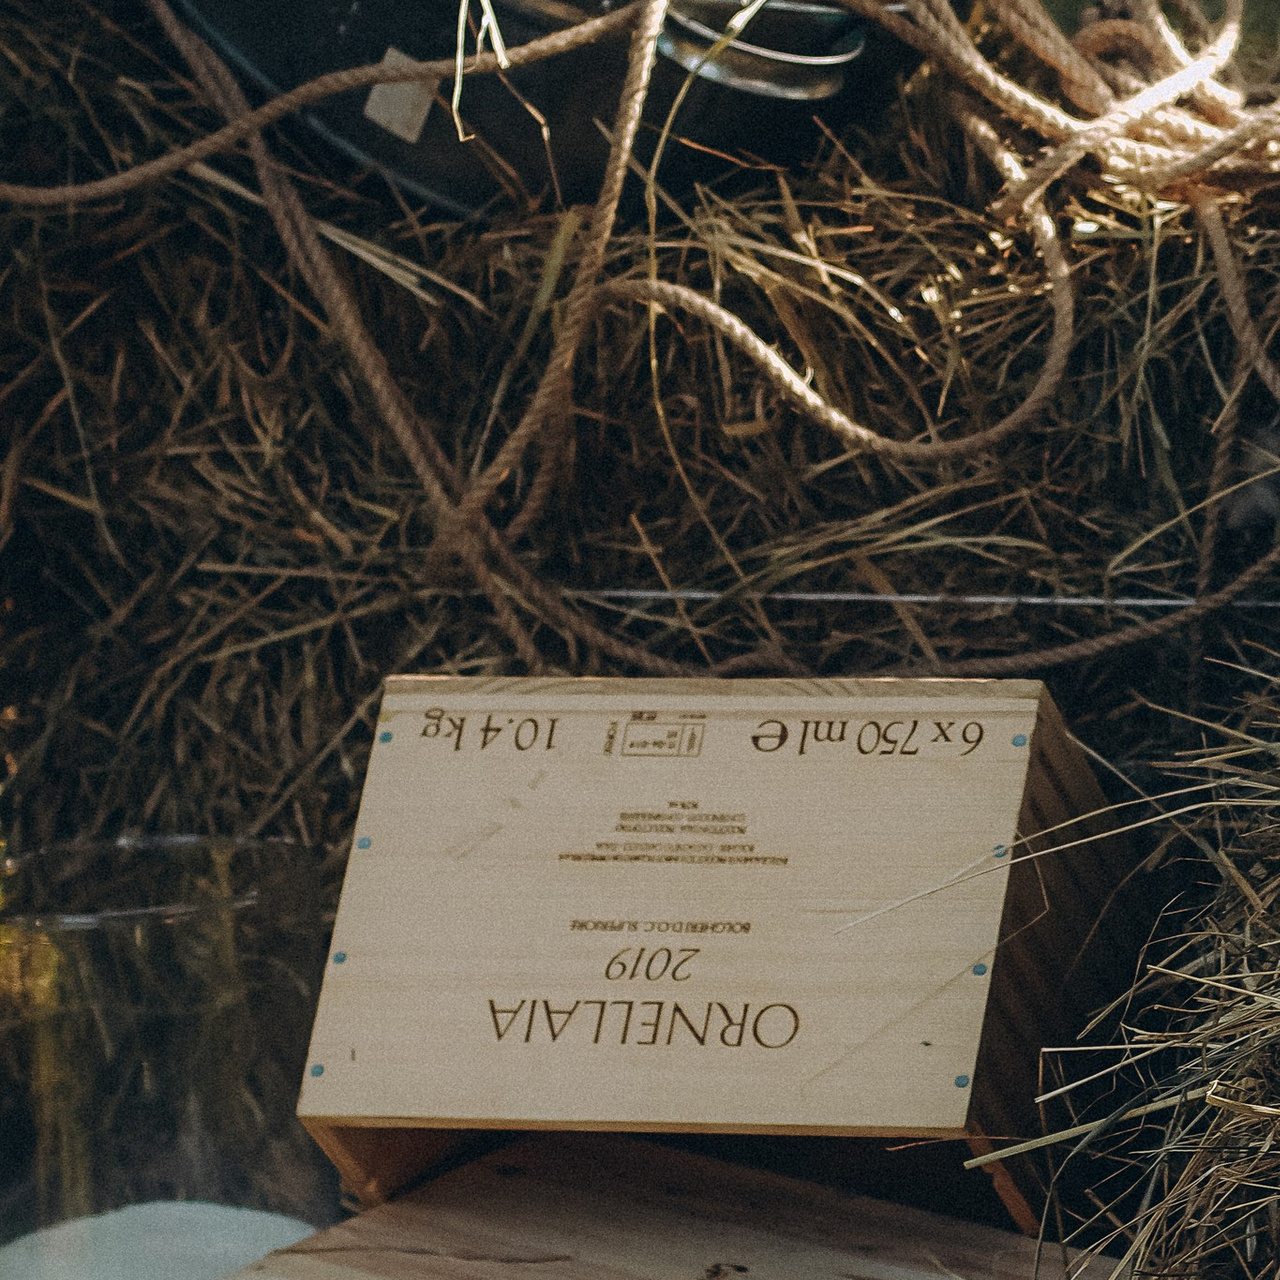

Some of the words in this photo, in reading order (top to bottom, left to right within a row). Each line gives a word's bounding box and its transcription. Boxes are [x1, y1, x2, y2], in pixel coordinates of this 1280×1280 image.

[420, 708, 466, 752] kg
[479, 714, 559, 750] 10.4
[798, 720, 848, 756] ml
[855, 720, 919, 756] 750
[930, 721, 955, 743] x
[961, 721, 986, 756] 6
[570, 919, 638, 934] SUPERIORE
[604, 947, 701, 982] 2019
[488, 998, 801, 1050] ORNELLAIA
